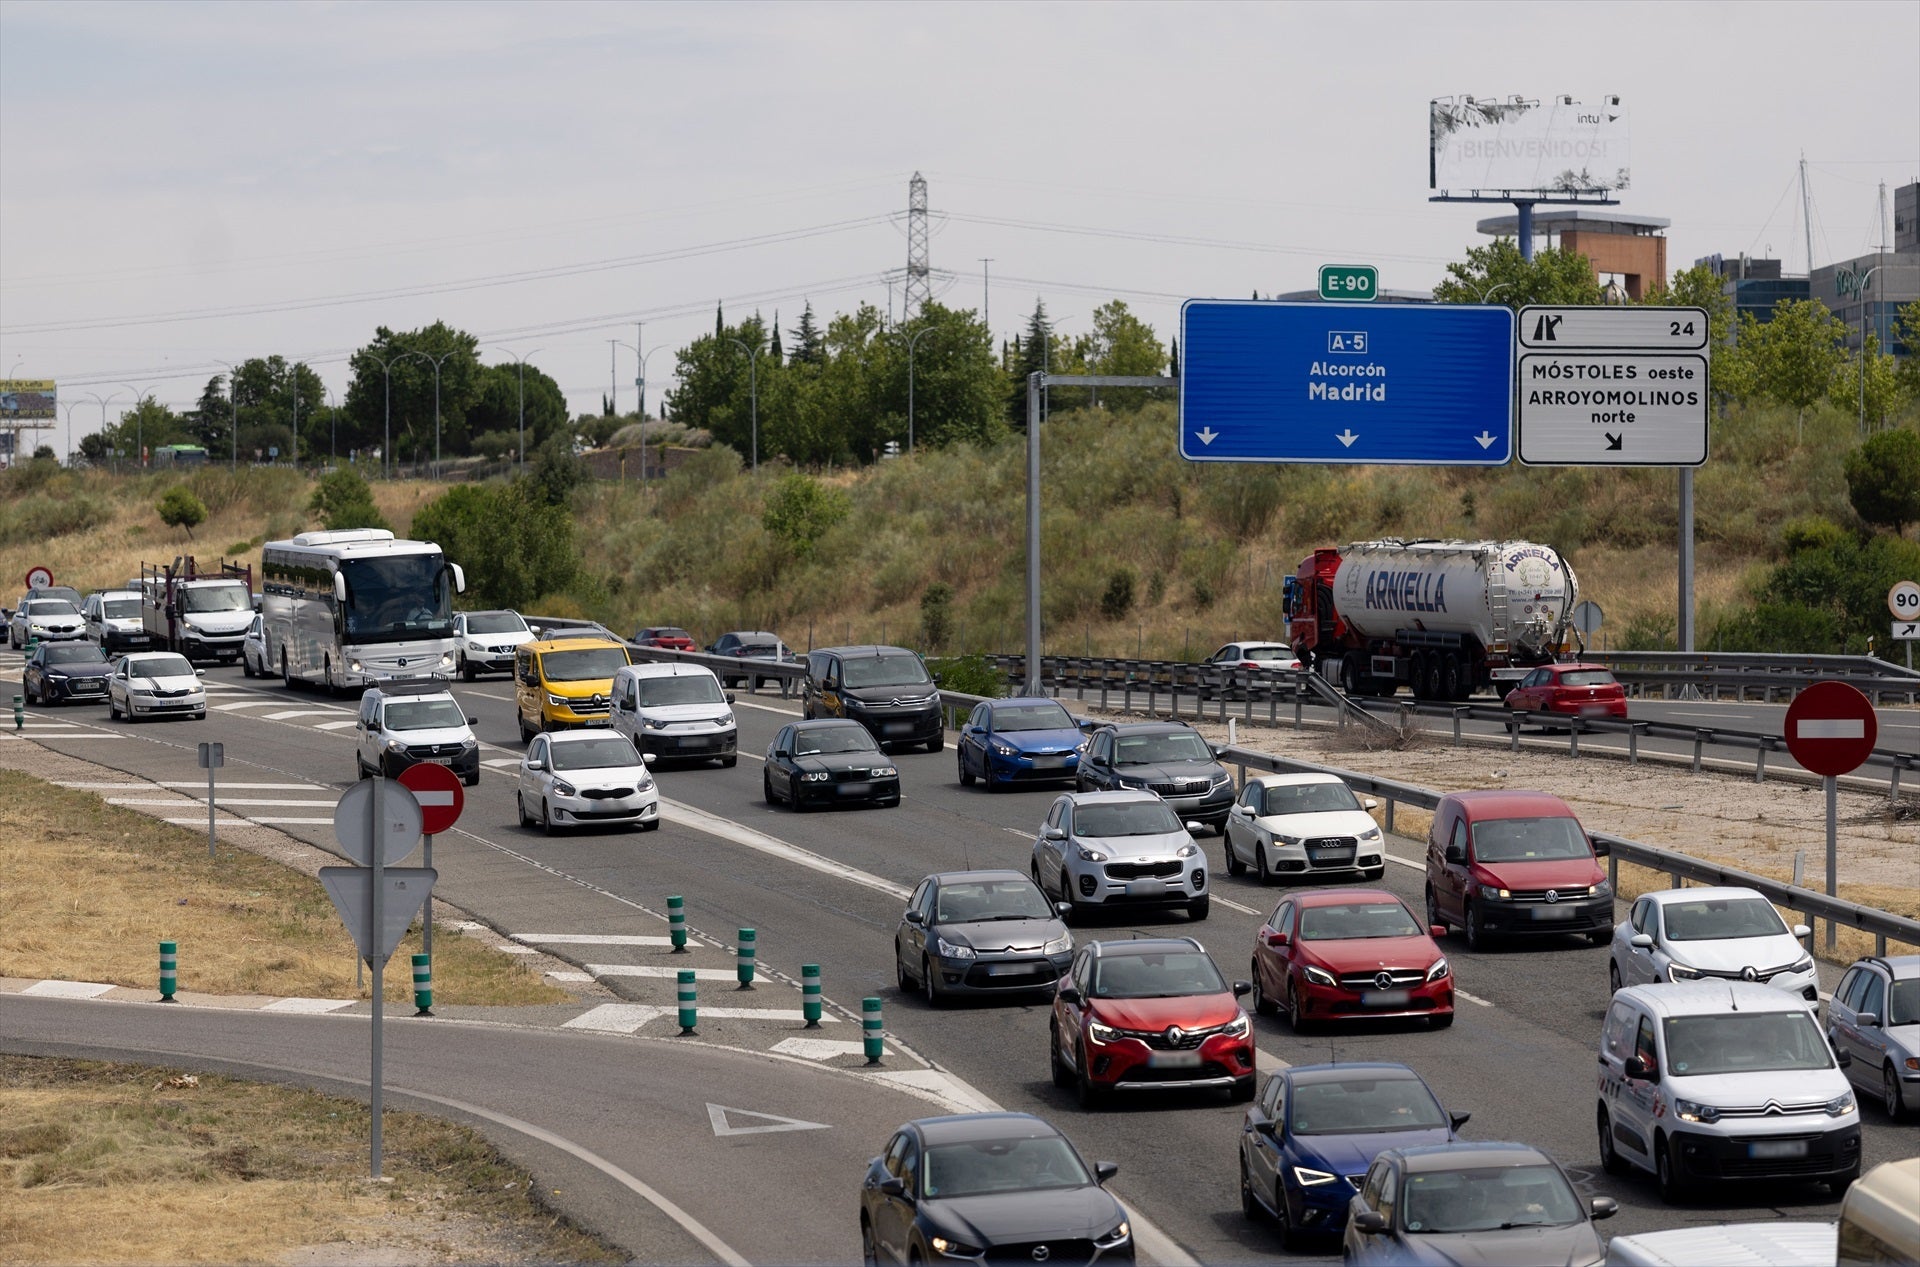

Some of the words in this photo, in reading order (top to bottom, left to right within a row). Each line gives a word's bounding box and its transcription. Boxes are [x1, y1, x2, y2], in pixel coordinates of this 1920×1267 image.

[1577, 114, 1600, 124] intu
[1457, 140, 1607, 162] ¡BIENVENIDOS!
[1328, 275, 1369, 291] E-90
[1670, 321, 1695, 336] 24
[1332, 334, 1364, 350] A-5
[1309, 361, 1386, 377] Alcorcón
[1532, 361, 1637, 380] MÓSTOLES
[1648, 366, 1694, 380] oeste
[1309, 382, 1386, 402] Madrid
[1528, 390, 1698, 406] ARROYOMOLINOS
[1591, 409, 1636, 424] norte
[1505, 549, 1560, 573] ARNIELLA
[1366, 570, 1447, 613] ARNIELLA
[1896, 593, 1919, 607] 90
